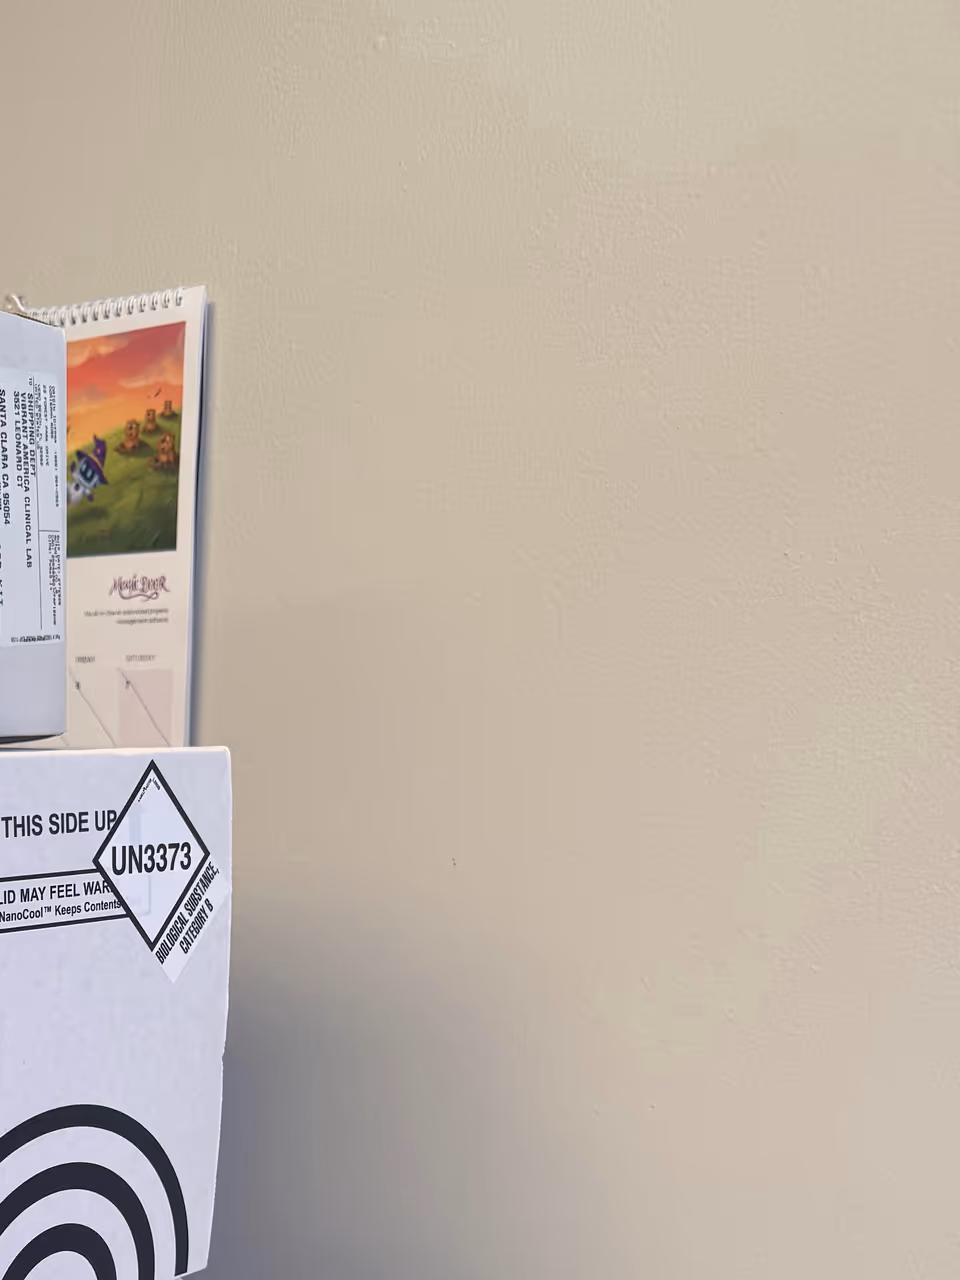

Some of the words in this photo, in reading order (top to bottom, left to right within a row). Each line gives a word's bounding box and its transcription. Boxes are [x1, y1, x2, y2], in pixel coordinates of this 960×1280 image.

[27, 393, 35, 445] SHIPPING
[0, 432, 8, 469] CLARA
[2, 474, 9, 491] CA
[2, 492, 10, 525] 95054
[24, 497, 32, 545] CLINICAL
[1, 814, 43, 838] THIS
[49, 812, 89, 835] SIDE
[111, 841, 192, 875] UN3373
[20, 886, 46, 902] MAY
[50, 884, 80, 900] FEEL
[84, 880, 113, 896] WAR
[55, 904, 81, 916] Keeps
[84, 899, 121, 912] Contents
[155, 912, 189, 965] BIOLOGICAL
[179, 907, 209, 955] CATEGORY
[206, 898, 214, 913] B
